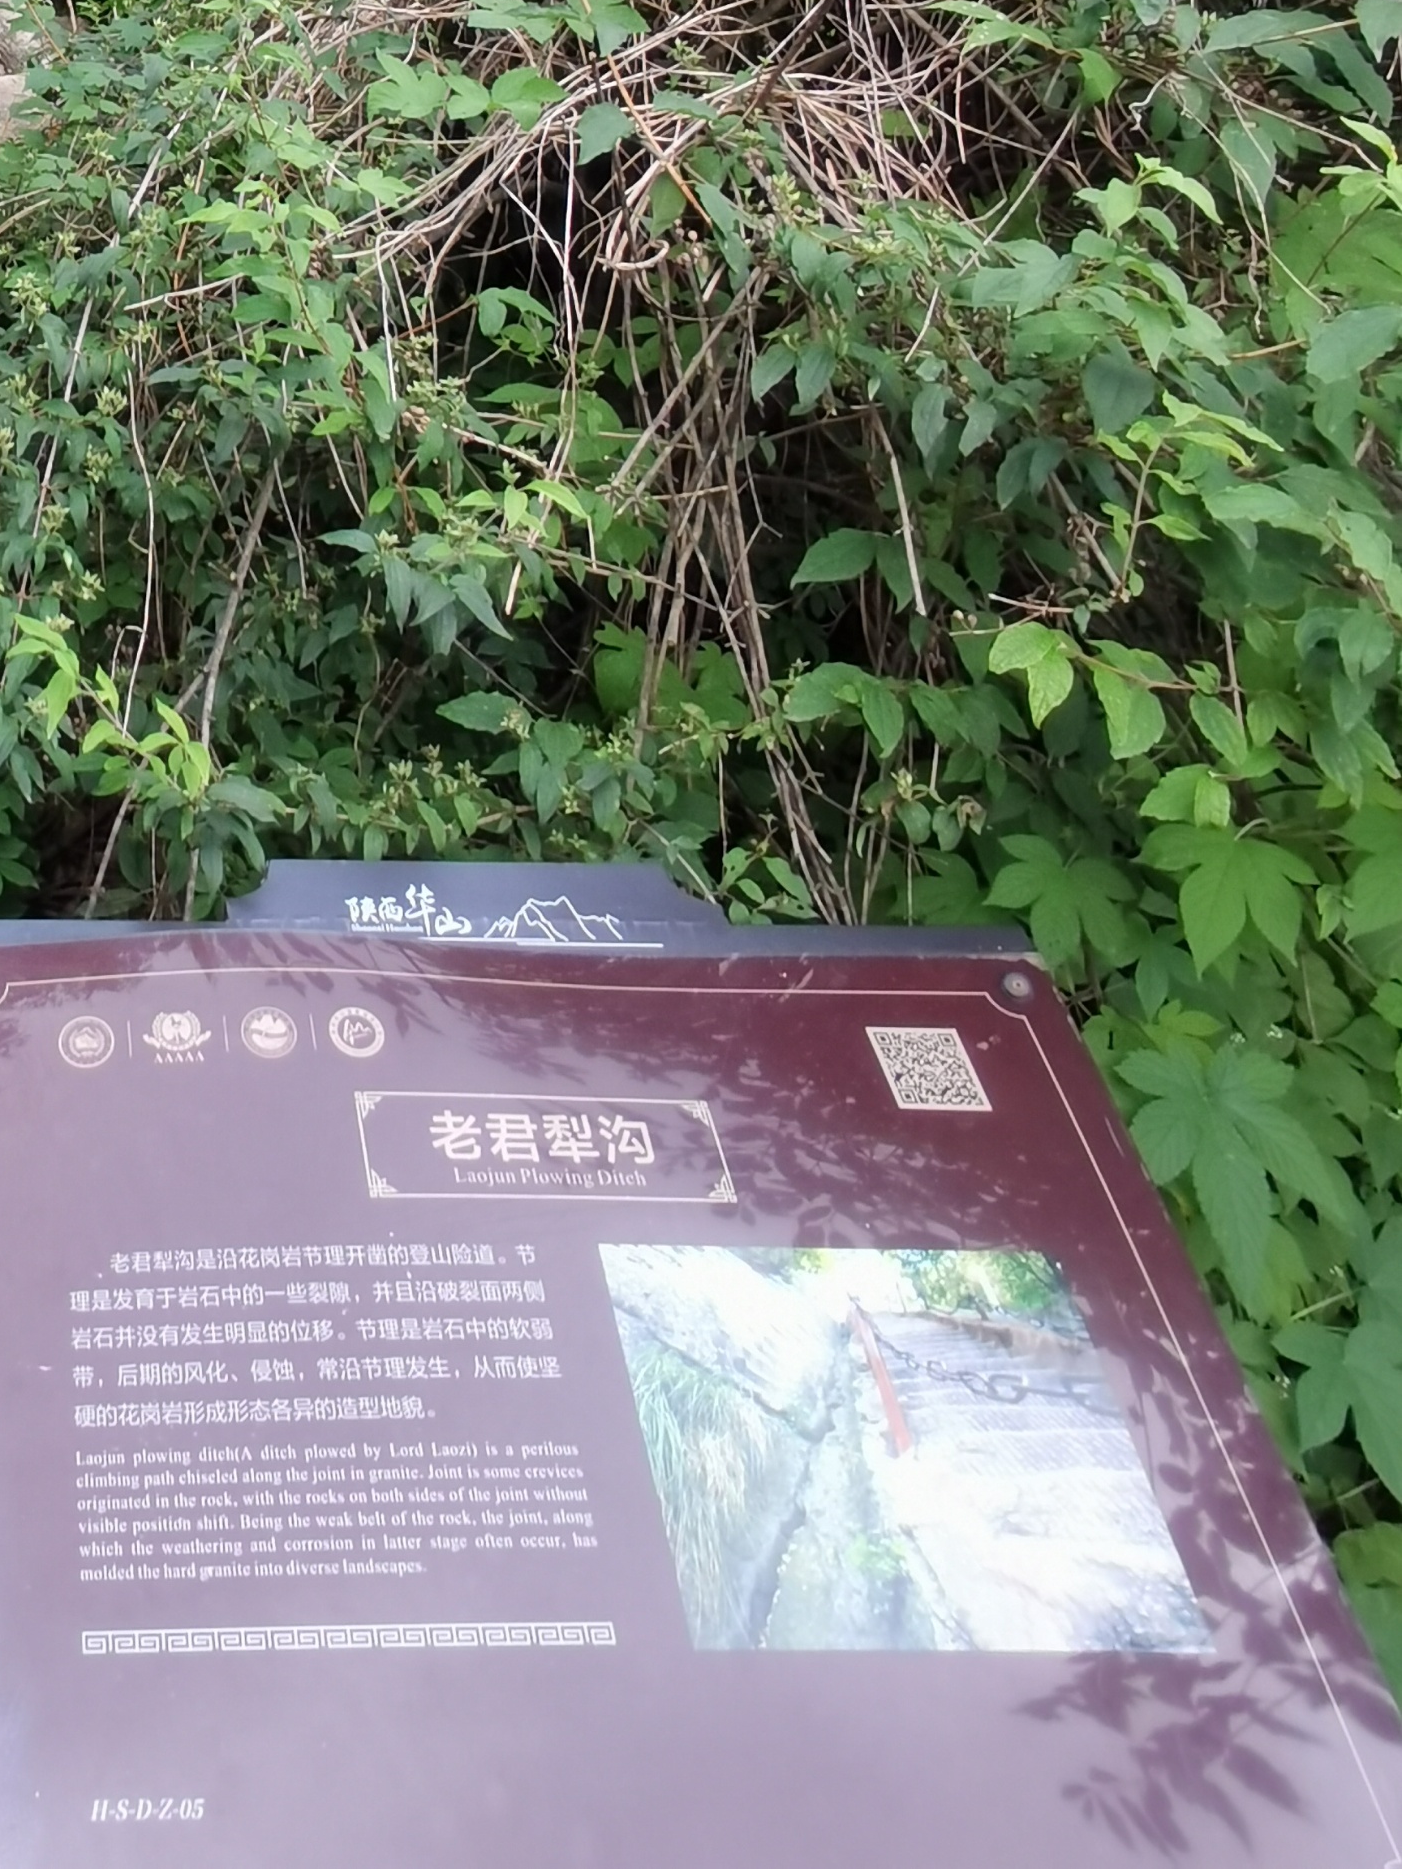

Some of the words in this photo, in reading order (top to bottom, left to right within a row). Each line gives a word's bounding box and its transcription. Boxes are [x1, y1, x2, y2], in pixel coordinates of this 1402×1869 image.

[344, 883, 472, 937] 陕西华山
[429, 1110, 655, 1164] 老君犁沟
[454, 1166, 516, 1187] Laojun
[520, 1167, 594, 1188] Plowing
[597, 1168, 647, 1187] Ditch
[76, 1451, 125, 1467] Laojun
[133, 1448, 191, 1467] plowing
[261, 1444, 296, 1461] ditch
[305, 1443, 356, 1462] plowed
[364, 1443, 380, 1461] by
[390, 1442, 423, 1458] Lord
[486, 1441, 498, 1456] is
[506, 1445, 513, 1455] a
[521, 1442, 579, 1459] perilous
[76, 1472, 139, 1489] climbing
[144, 1471, 174, 1489] path
[179, 1469, 238, 1484] chiseled
[242, 1469, 282, 1484] along
[286, 1467, 308, 1481] the
[312, 1466, 345, 1484] joint
[351, 1466, 364, 1480] in
[428, 1464, 462, 1479] Joint
[468, 1464, 479, 1478] is
[483, 1467, 520, 1478] some
[525, 1463, 583, 1478] crevices
[77, 1494, 150, 1513] originated
[156, 1494, 169, 1508] in
[174, 1493, 196, 1507] the
[243, 1491, 274, 1506] with
[279, 1490, 301, 1505] the
[306, 1489, 344, 1504] rocks
[349, 1492, 367, 1503] on
[372, 1488, 403, 1502] both
[408, 1487, 444, 1502] sides
[449, 1487, 465, 1501] of
[469, 1486, 490, 1501] the
[496, 1485, 528, 1504] joint
[533, 1486, 588, 1501] without
[79, 1517, 127, 1534] visible
[133, 1516, 191, 1536] position
[240, 1514, 282, 1531] Being
[288, 1513, 310, 1527] the
[316, 1512, 353, 1526] weak
[358, 1511, 386, 1526] belt
[391, 1511, 407, 1525] of
[412, 1510, 434, 1525] the
[482, 1510, 503, 1524] the
[553, 1509, 593, 1527] along
[79, 1541, 123, 1557] which
[131, 1540, 153, 1555] the
[162, 1538, 242, 1556] weathering
[251, 1536, 276, 1552] and
[284, 1536, 353, 1552] corrosion
[362, 1535, 375, 1550] in
[384, 1534, 421, 1549] latter
[430, 1534, 467, 1552] stage
[475, 1533, 513, 1547] often
[573, 1532, 597, 1547] has
[80, 1564, 134, 1581] molded
[138, 1564, 160, 1579] the
[164, 1563, 195, 1578] hard
[200, 1561, 250, 1581] granite
[255, 1561, 282, 1577] into
[287, 1560, 339, 1576] diverse
[91, 1798, 205, 1821] H-S-D-Z-05
